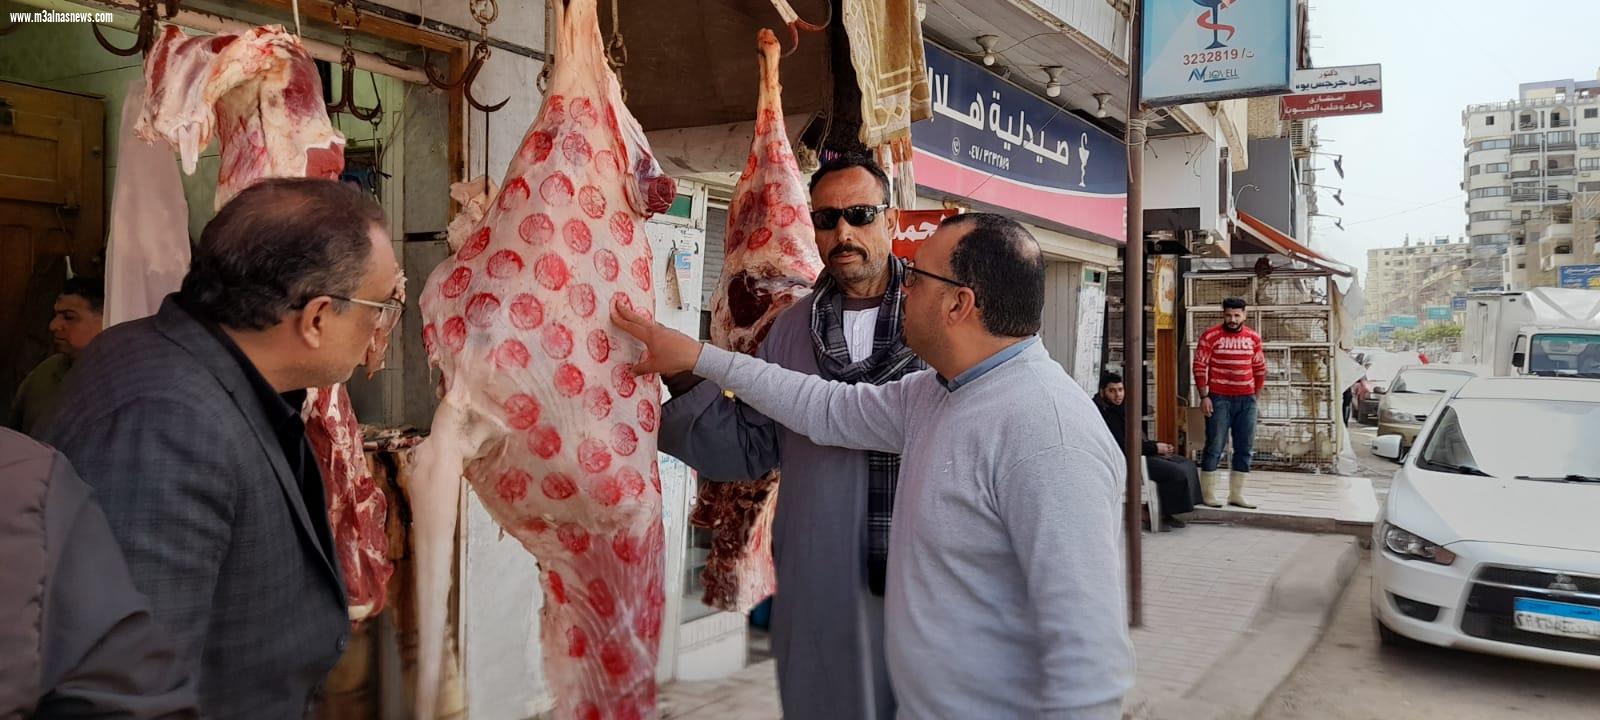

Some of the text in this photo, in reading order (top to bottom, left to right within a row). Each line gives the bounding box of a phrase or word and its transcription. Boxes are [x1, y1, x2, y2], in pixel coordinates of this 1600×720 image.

[1183, 48, 1238, 65] 3232819
[1310, 79, 1348, 90] جرجس
[1348, 75, 1378, 87] جمال
[989, 90, 1069, 166] صيدلية
[892, 214, 946, 243] حمد
